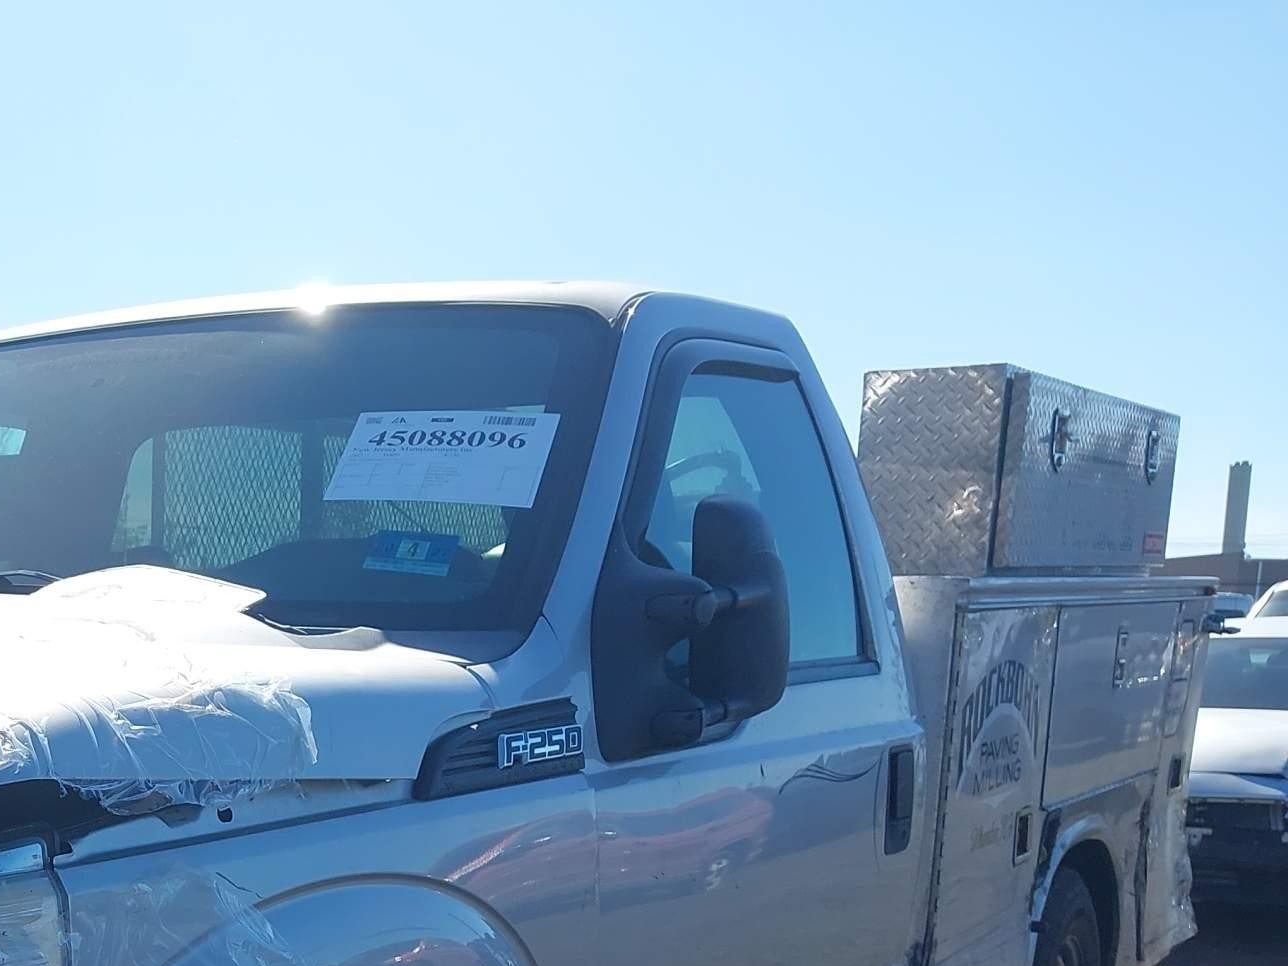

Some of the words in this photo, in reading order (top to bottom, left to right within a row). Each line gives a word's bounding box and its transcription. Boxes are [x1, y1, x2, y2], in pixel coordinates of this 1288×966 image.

[368, 429, 529, 450] 45088096
[407, 542, 419, 557] 4
[498, 724, 584, 769] F-250
[980, 733, 1020, 763] PAVING
[972, 758, 1022, 796] MILLING
